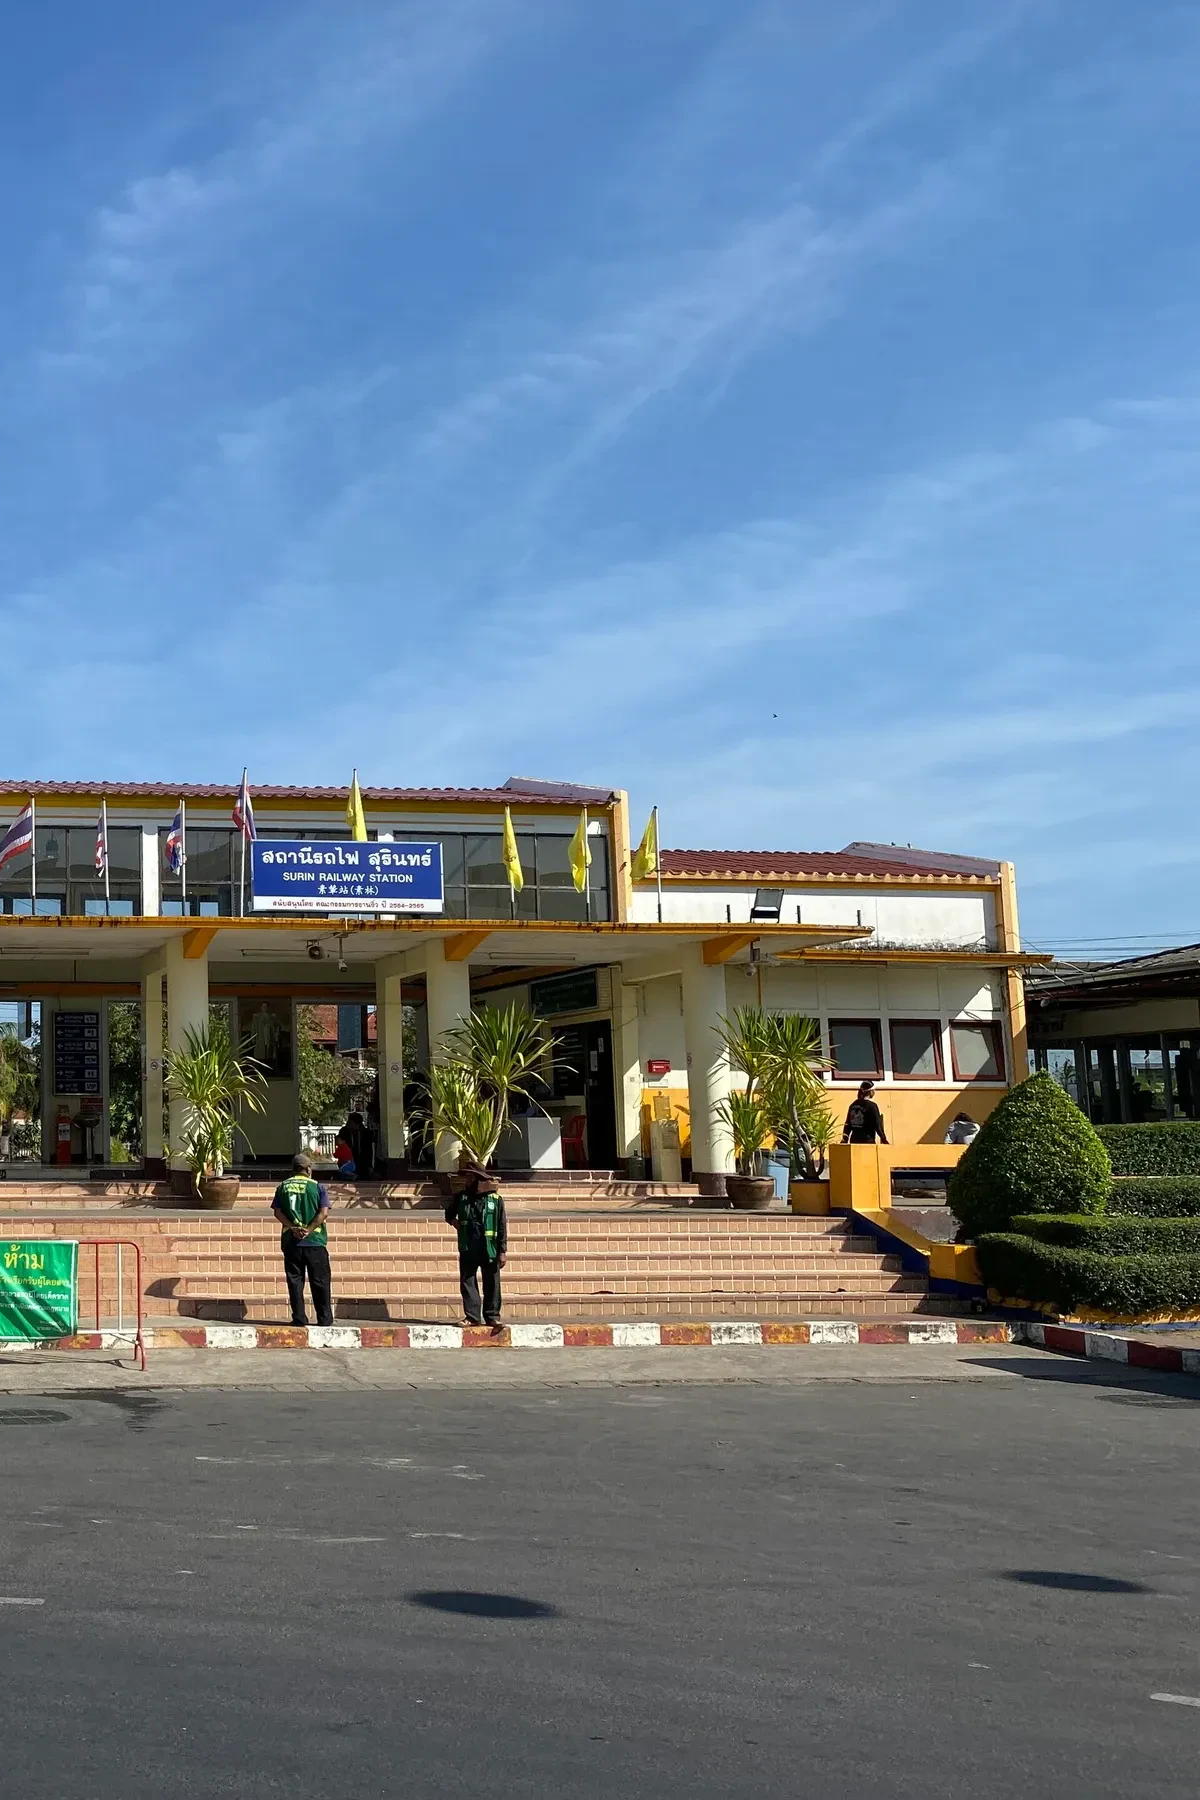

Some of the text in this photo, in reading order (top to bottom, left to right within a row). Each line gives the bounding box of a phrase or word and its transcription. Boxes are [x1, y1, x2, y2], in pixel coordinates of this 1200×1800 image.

[262, 847, 432, 872] สถานีรถไฟ สุรินทร์
[282, 872, 413, 883] SURIN RAILWAY STATION
[272, 899, 314, 908] สนับสนุนโดย
[4, 1244, 44, 1270] ห้าม
